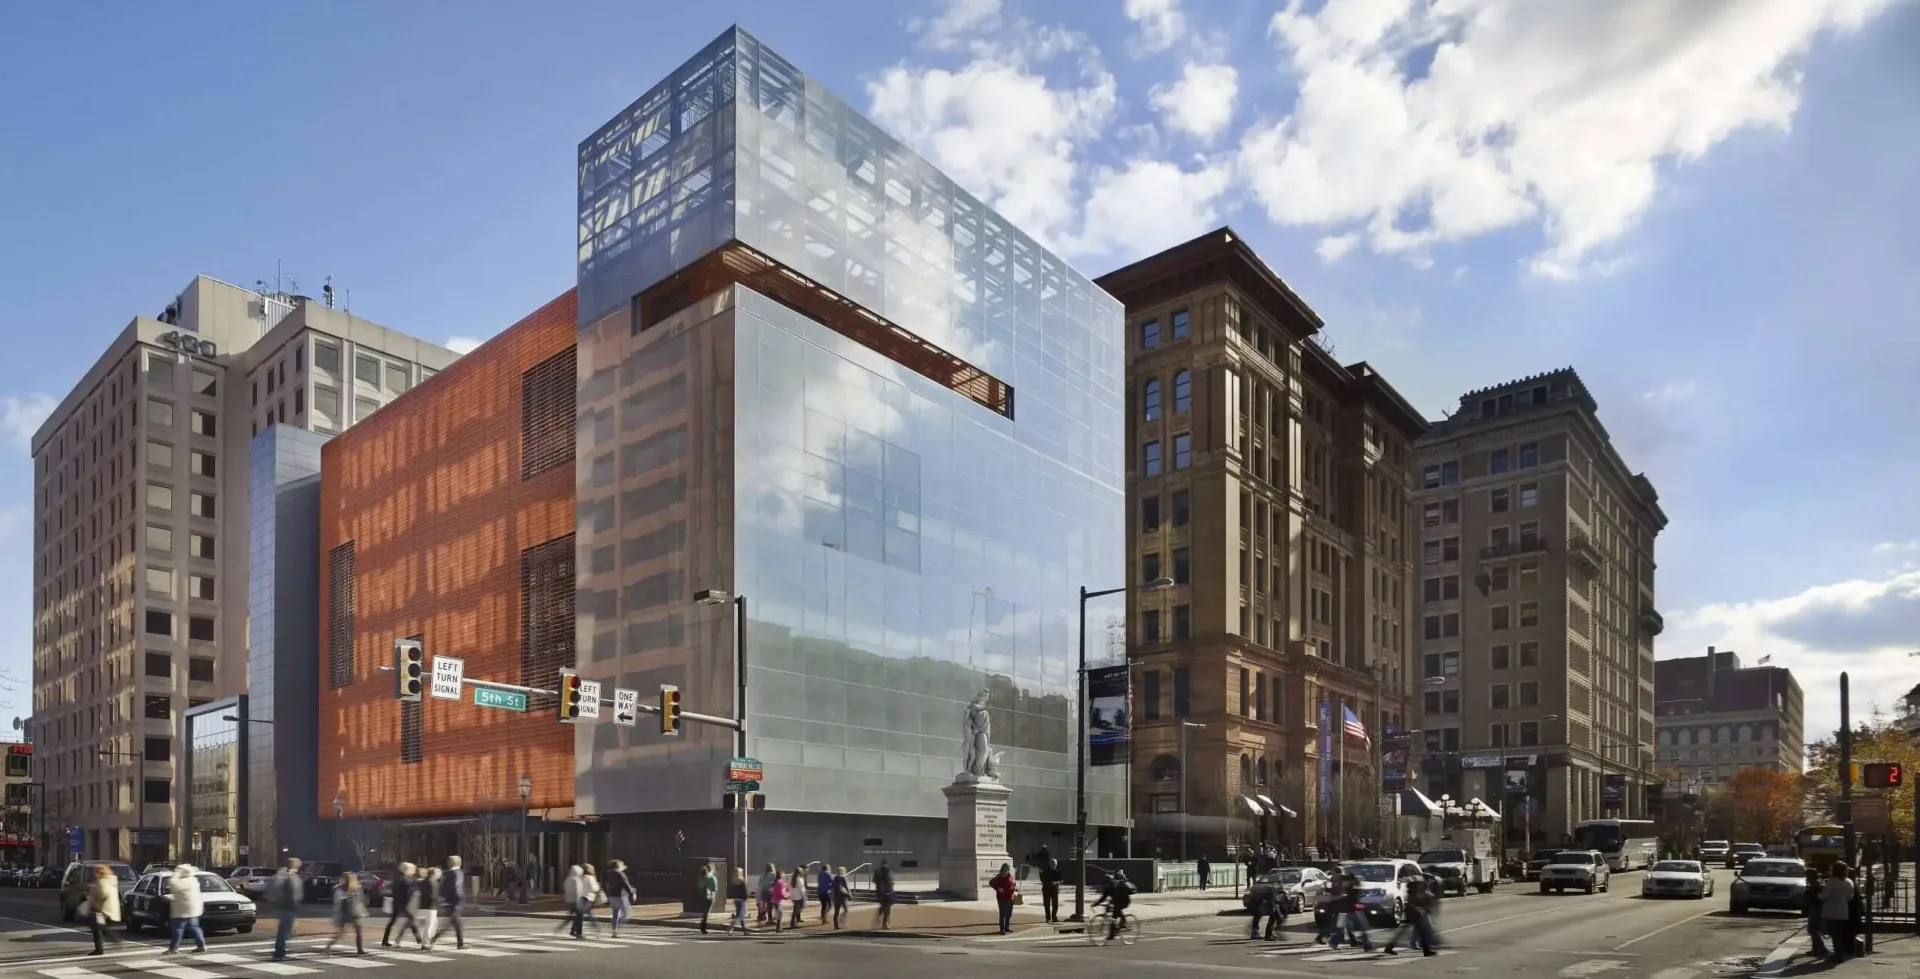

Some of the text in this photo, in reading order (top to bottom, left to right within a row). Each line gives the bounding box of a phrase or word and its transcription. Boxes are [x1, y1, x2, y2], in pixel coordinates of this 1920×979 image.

[164, 331, 216, 358] 400
[438, 661, 459, 672] LEFT
[437, 673, 458, 684] TURN
[434, 684, 459, 695] SIGNAL
[481, 691, 519, 707] 5th St
[618, 691, 634, 702] ONE
[580, 706, 597, 715] IGNAL
[618, 702, 633, 712] WAY
[1889, 766, 1899, 783] 2
